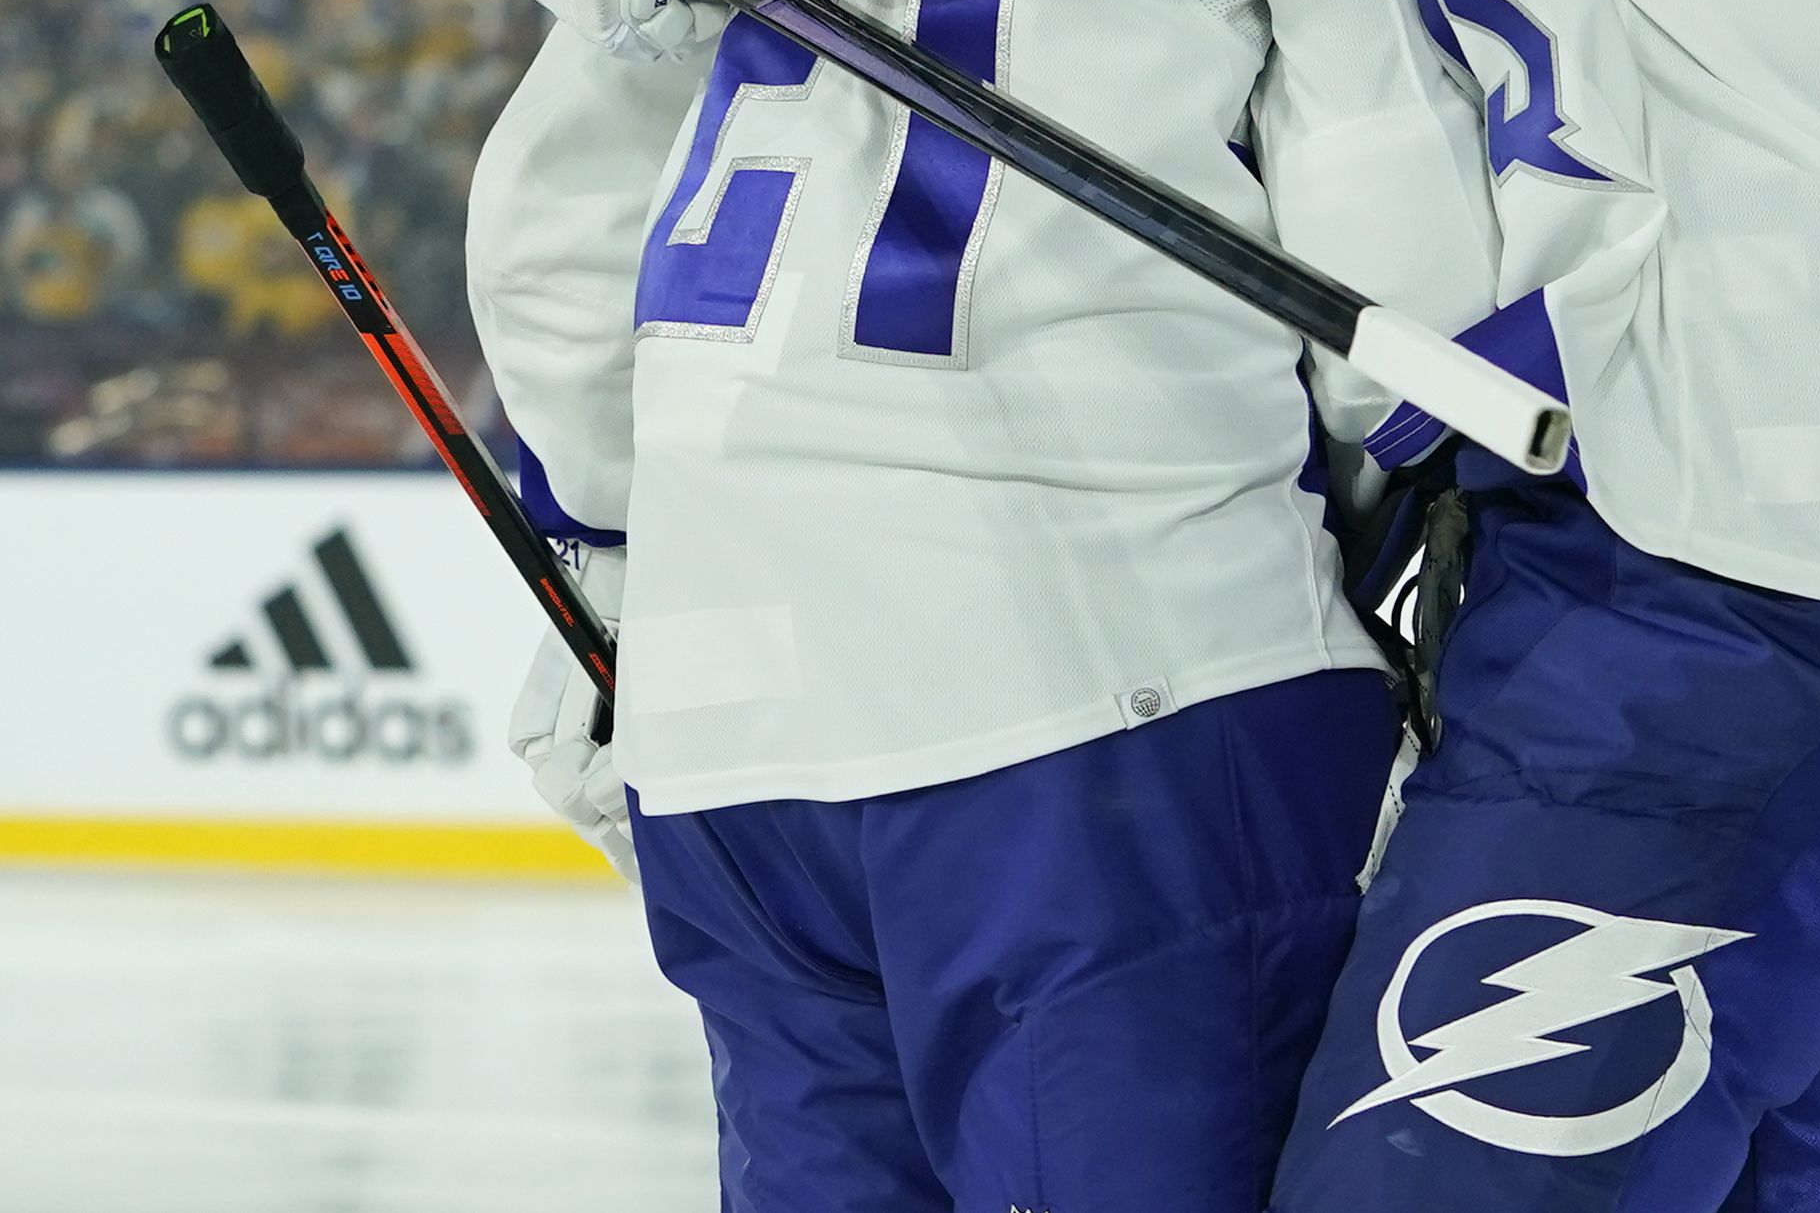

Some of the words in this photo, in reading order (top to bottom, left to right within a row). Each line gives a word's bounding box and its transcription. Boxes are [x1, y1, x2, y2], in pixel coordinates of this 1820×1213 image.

[338, 284, 363, 300] 10
[556, 538, 580, 571] 21
[170, 673, 474, 762] adidas
